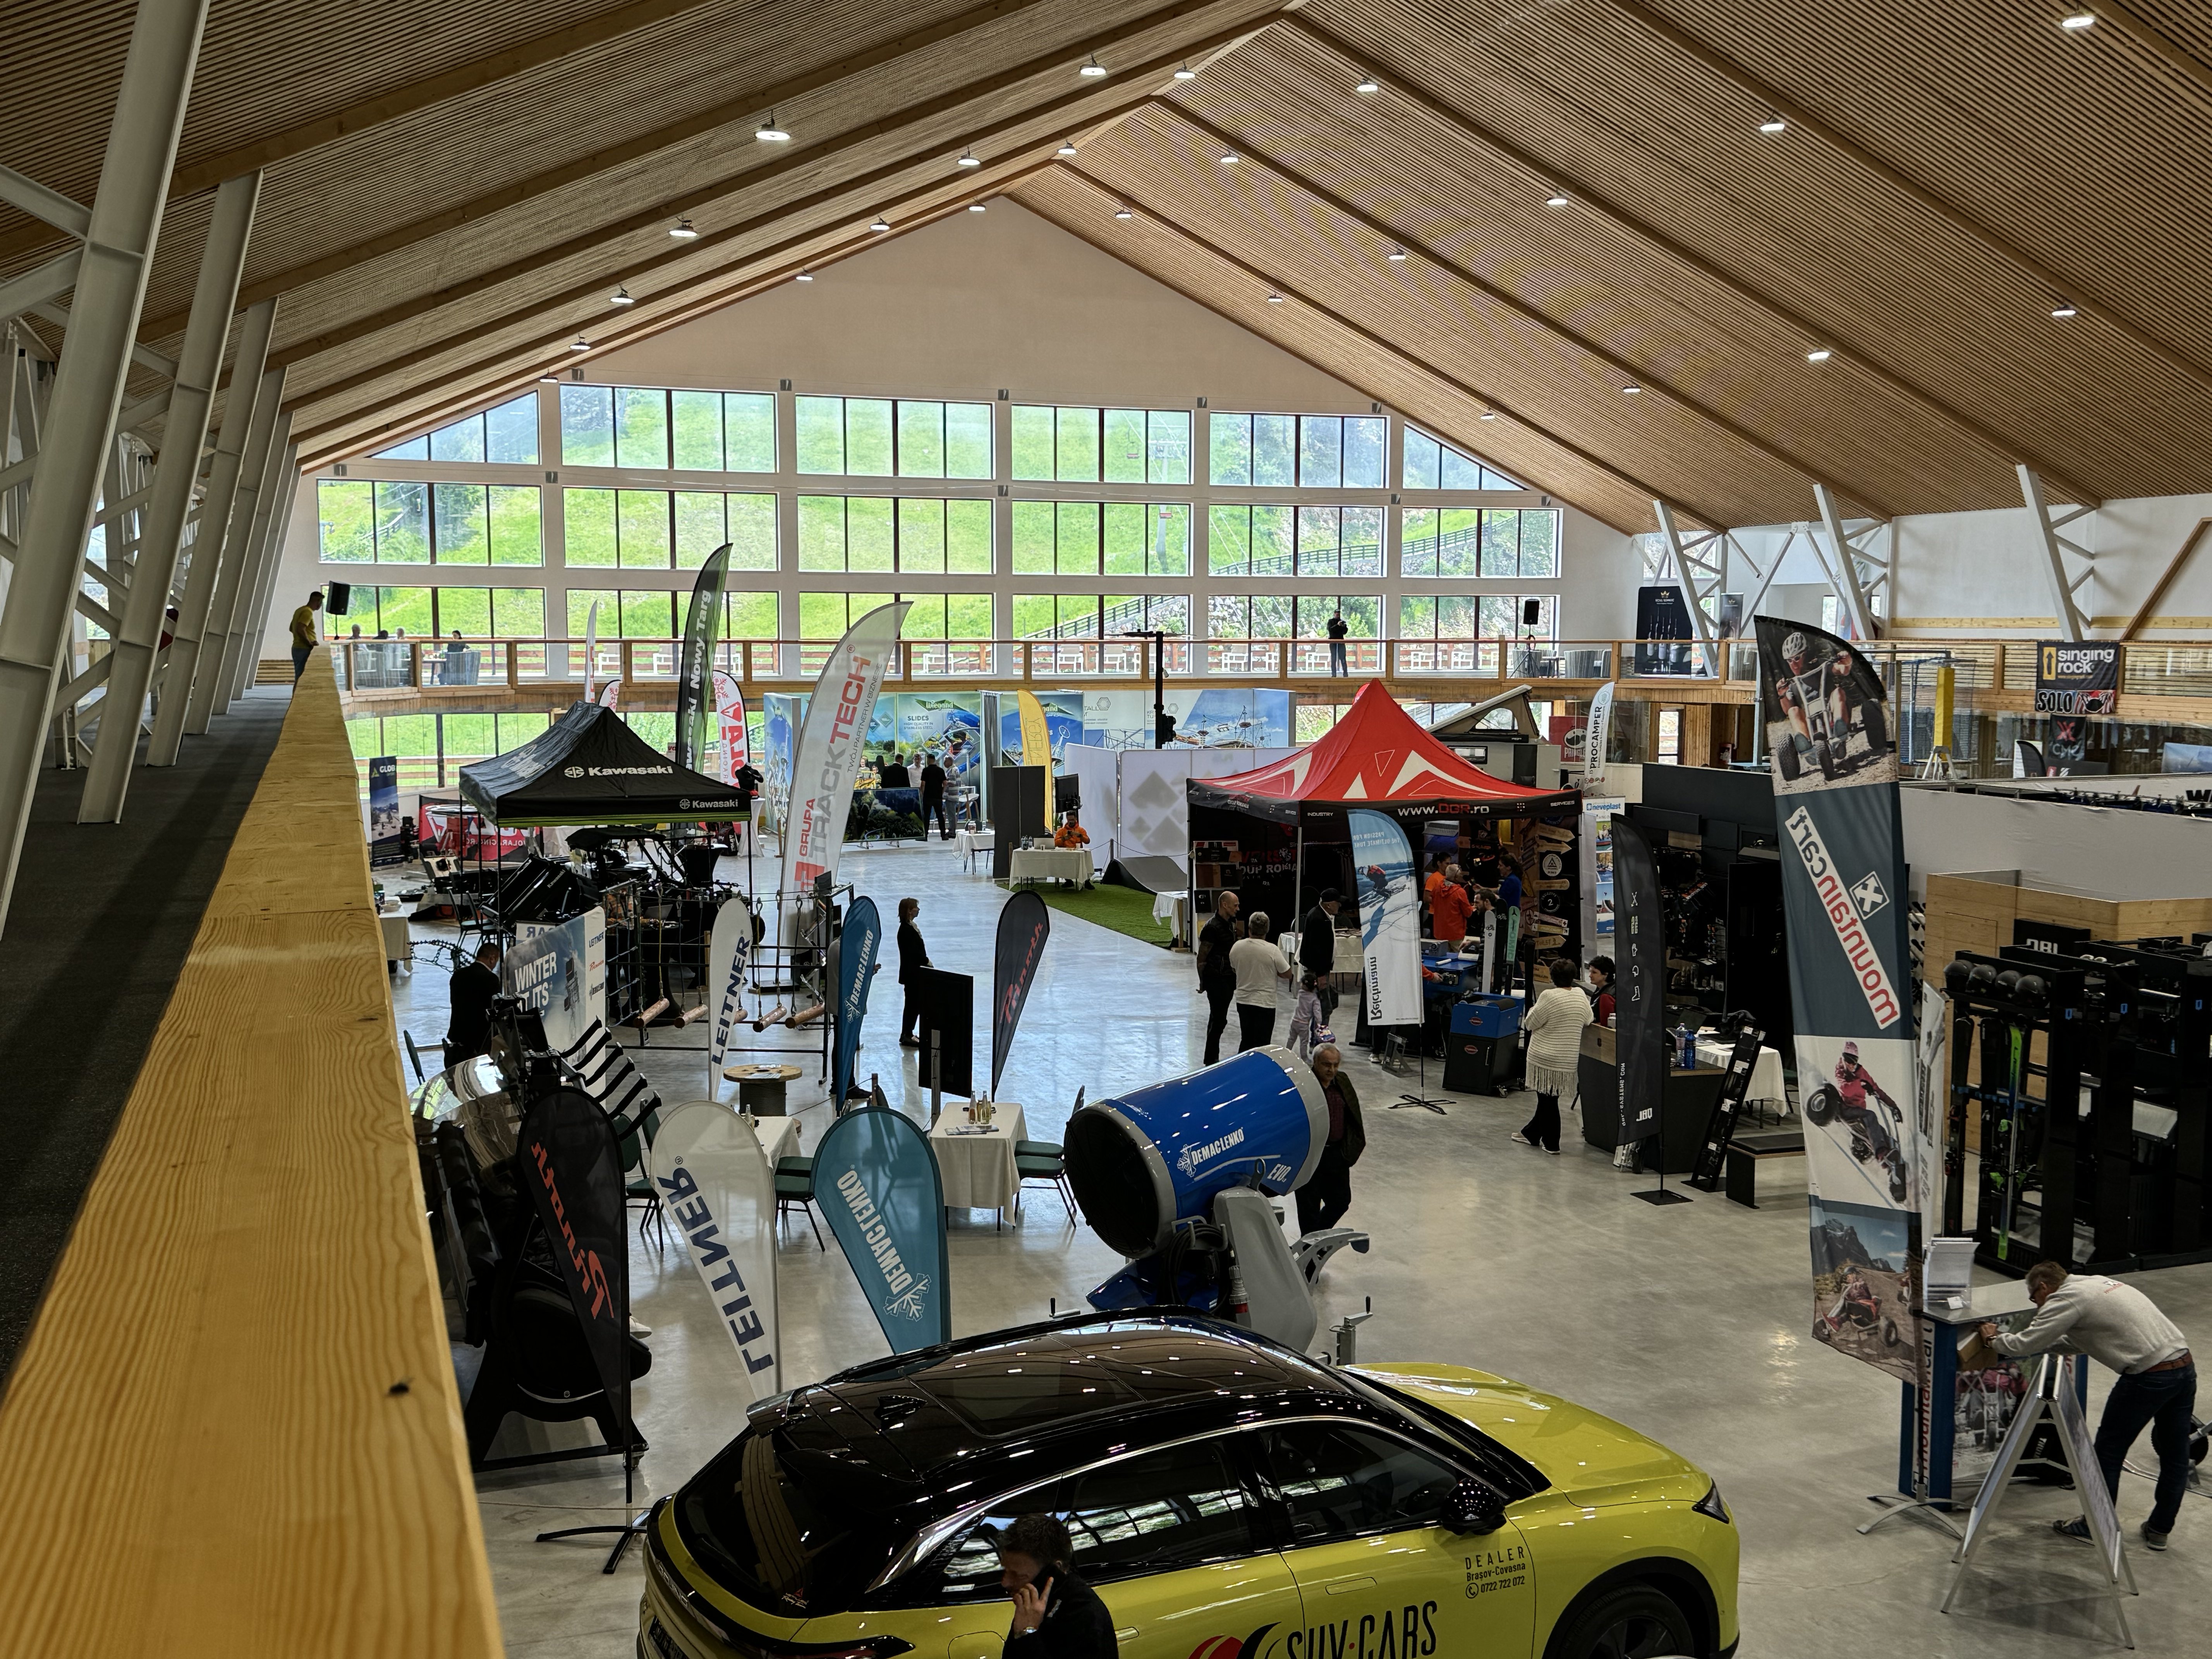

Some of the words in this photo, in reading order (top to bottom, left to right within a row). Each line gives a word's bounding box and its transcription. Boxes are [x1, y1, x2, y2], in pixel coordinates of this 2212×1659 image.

[696, 590, 712, 632] Targ
[690, 636, 705, 690] Nowy
[2057, 649, 2115, 663] singing
[2057, 662, 2092, 673] rock
[926, 700, 954, 710] Wiegand
[2036, 691, 2073, 713] SOLO
[686, 697, 697, 770] awasaki
[854, 708, 869, 748] PARTNER
[1590, 706, 1602, 769] PROCAMPER
[589, 765, 673, 776] Kawasaki
[692, 799, 738, 809] Kawasaki
[1398, 803, 1489, 816] www.DGR.ro
[799, 798, 816, 857] GRUPA
[589, 932, 604, 948] LEITNER
[515, 951, 557, 993] WINTER
[850, 929, 874, 1005] DEMACLENKO
[532, 982, 549, 1008] ITS
[711, 935, 752, 1065] LEITNER
[1191, 1128, 1244, 1166] DEMACLENKO
[1267, 1163, 1291, 1182] EVO
[1465, 1546, 1525, 1570] DEALER
[1481, 1581, 1498, 1594] 0722
[1498, 1578, 1511, 1590] 722
[1512, 1575, 1525, 1587] 072
